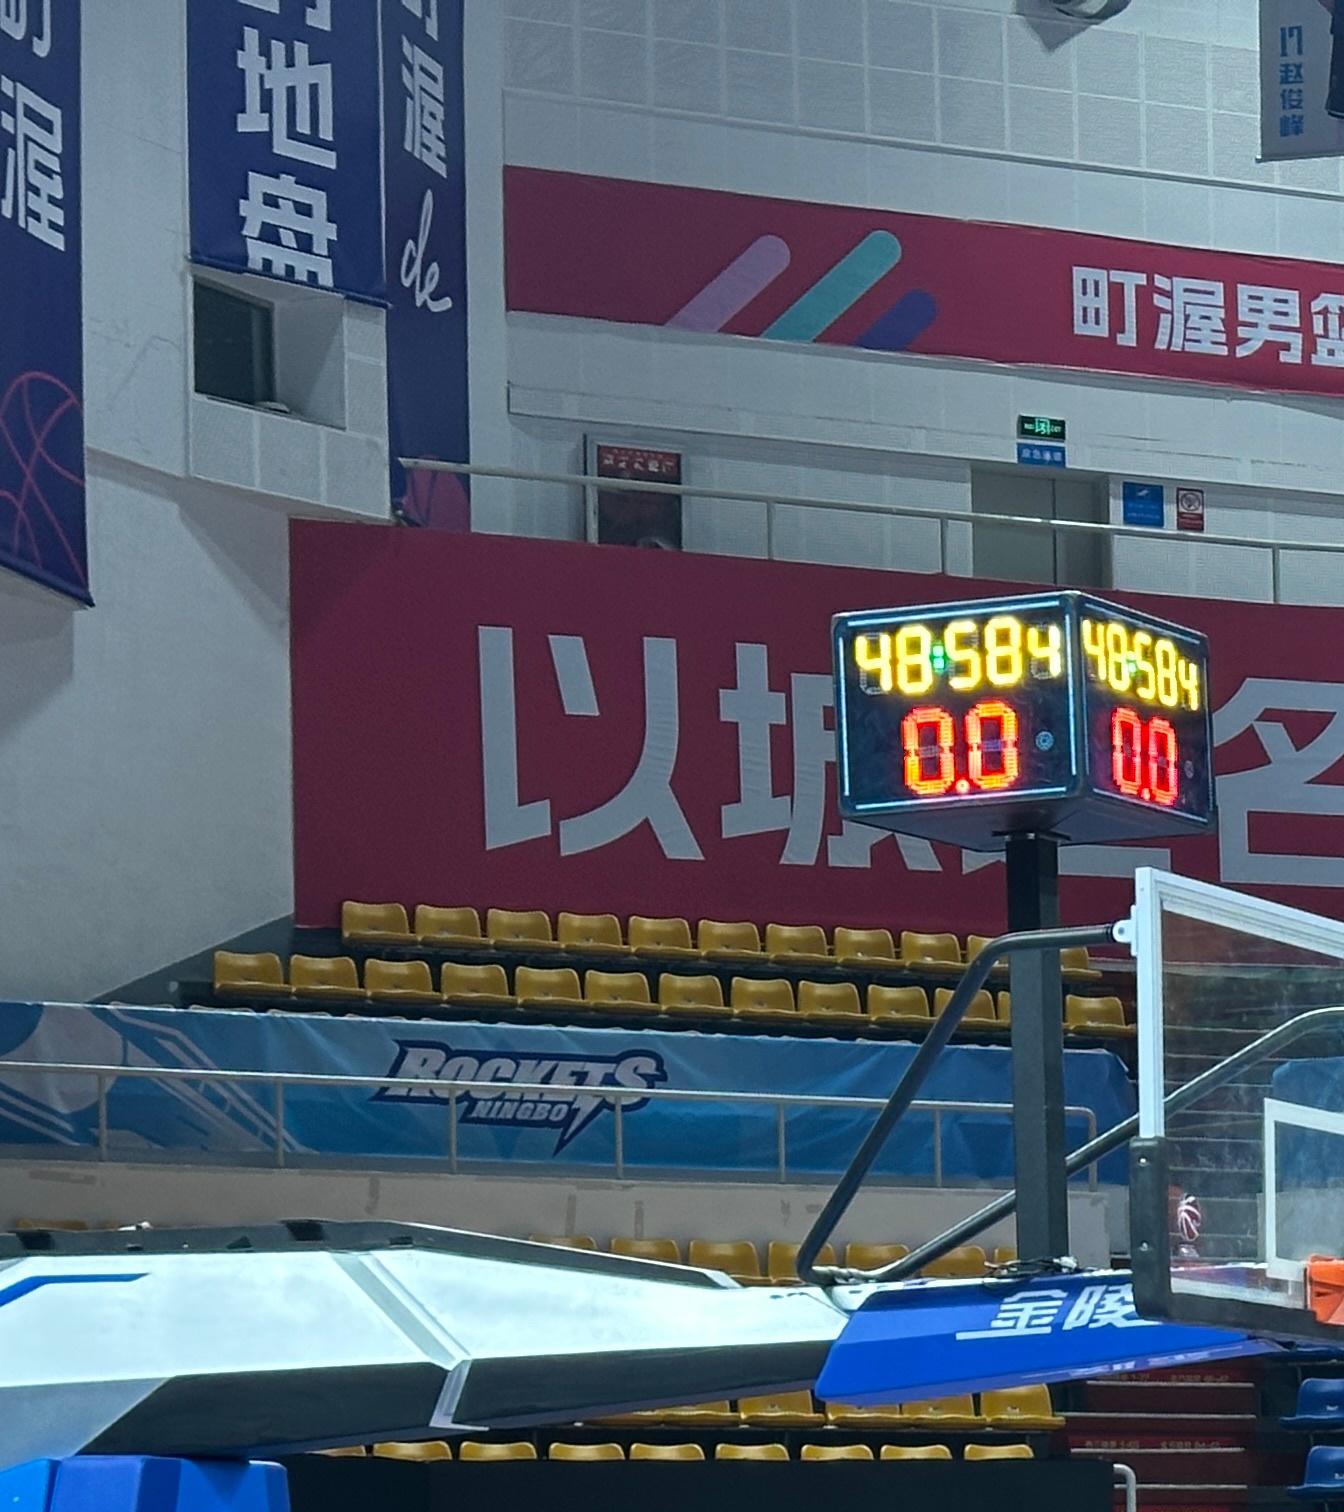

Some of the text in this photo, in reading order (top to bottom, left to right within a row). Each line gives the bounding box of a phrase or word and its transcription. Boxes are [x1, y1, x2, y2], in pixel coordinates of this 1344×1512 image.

[236, 0, 338, 287] 地盘
[902, 699, 1020, 796] 0.0
[1111, 706, 1179, 807] 0.0
[383, 1046, 661, 1126] ROCKETS
[469, 1099, 569, 1122] NINGBO
